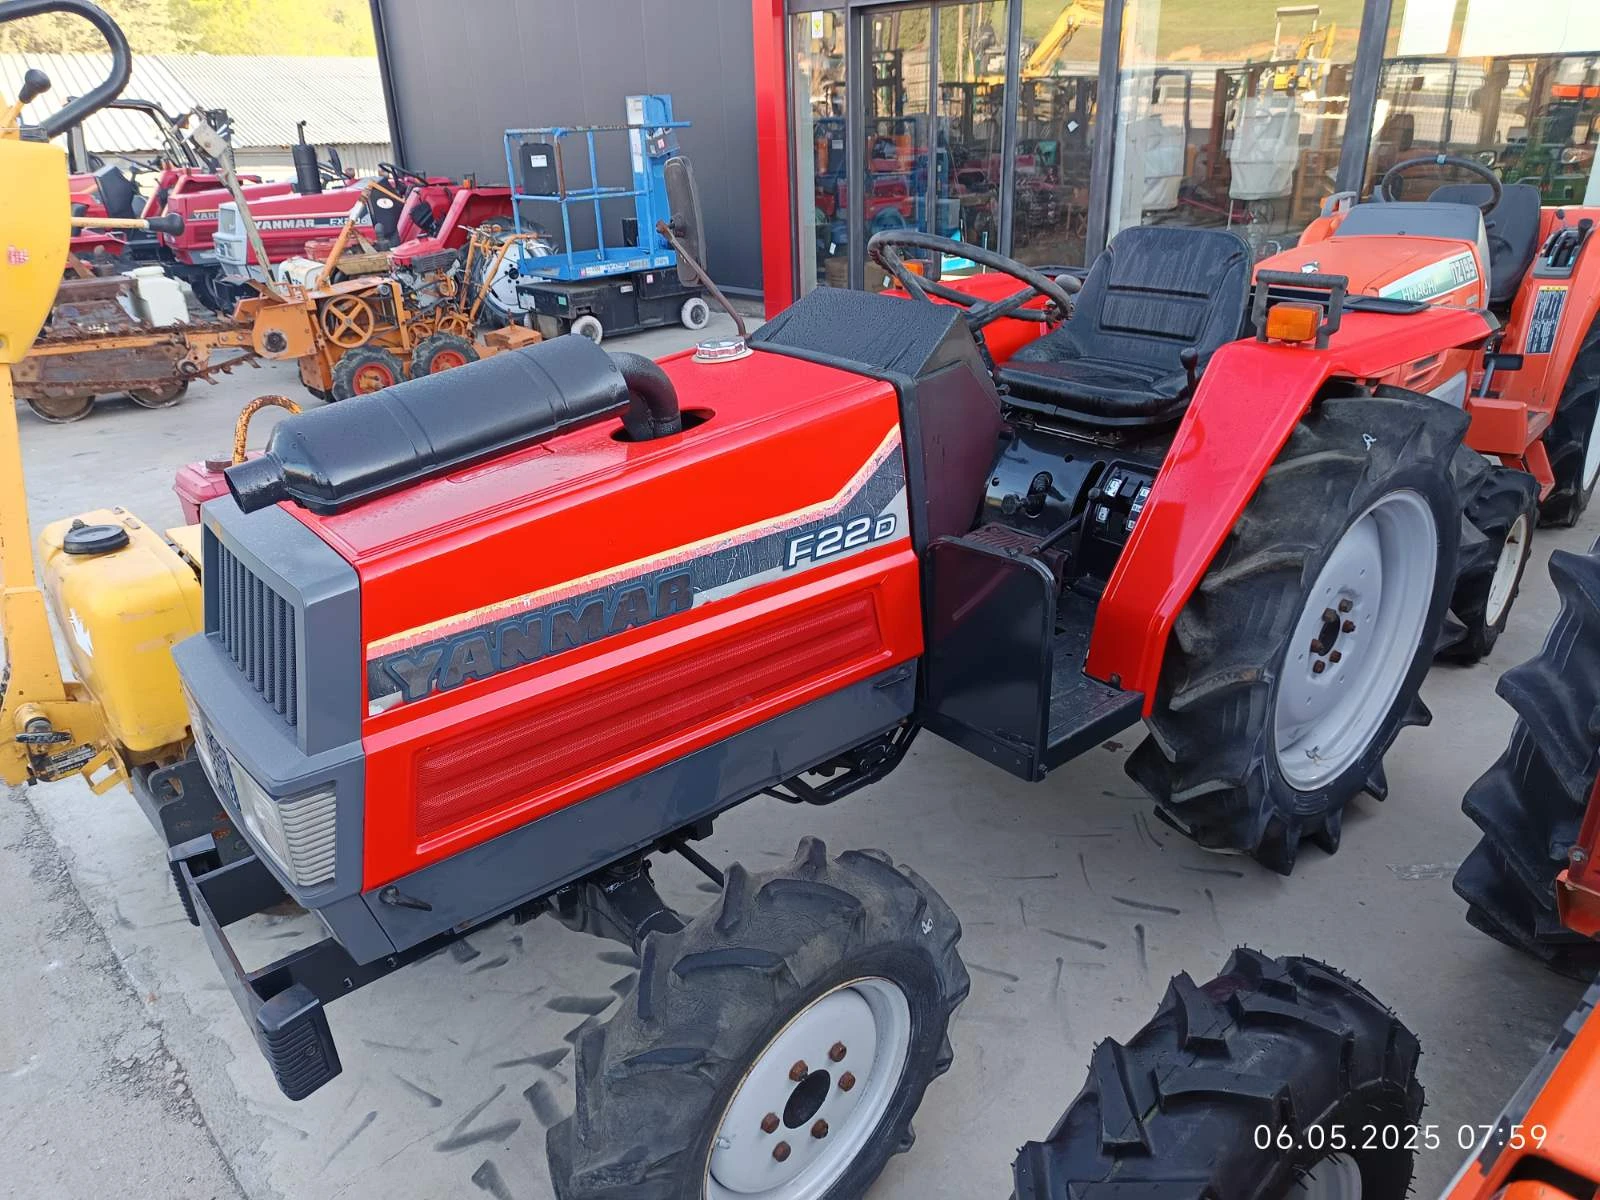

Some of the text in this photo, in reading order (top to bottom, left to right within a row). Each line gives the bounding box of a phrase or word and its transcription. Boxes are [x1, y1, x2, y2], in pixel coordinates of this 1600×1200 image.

[253, 218, 314, 230] YANMAR
[386, 514, 897, 701] YANMAR F22D
